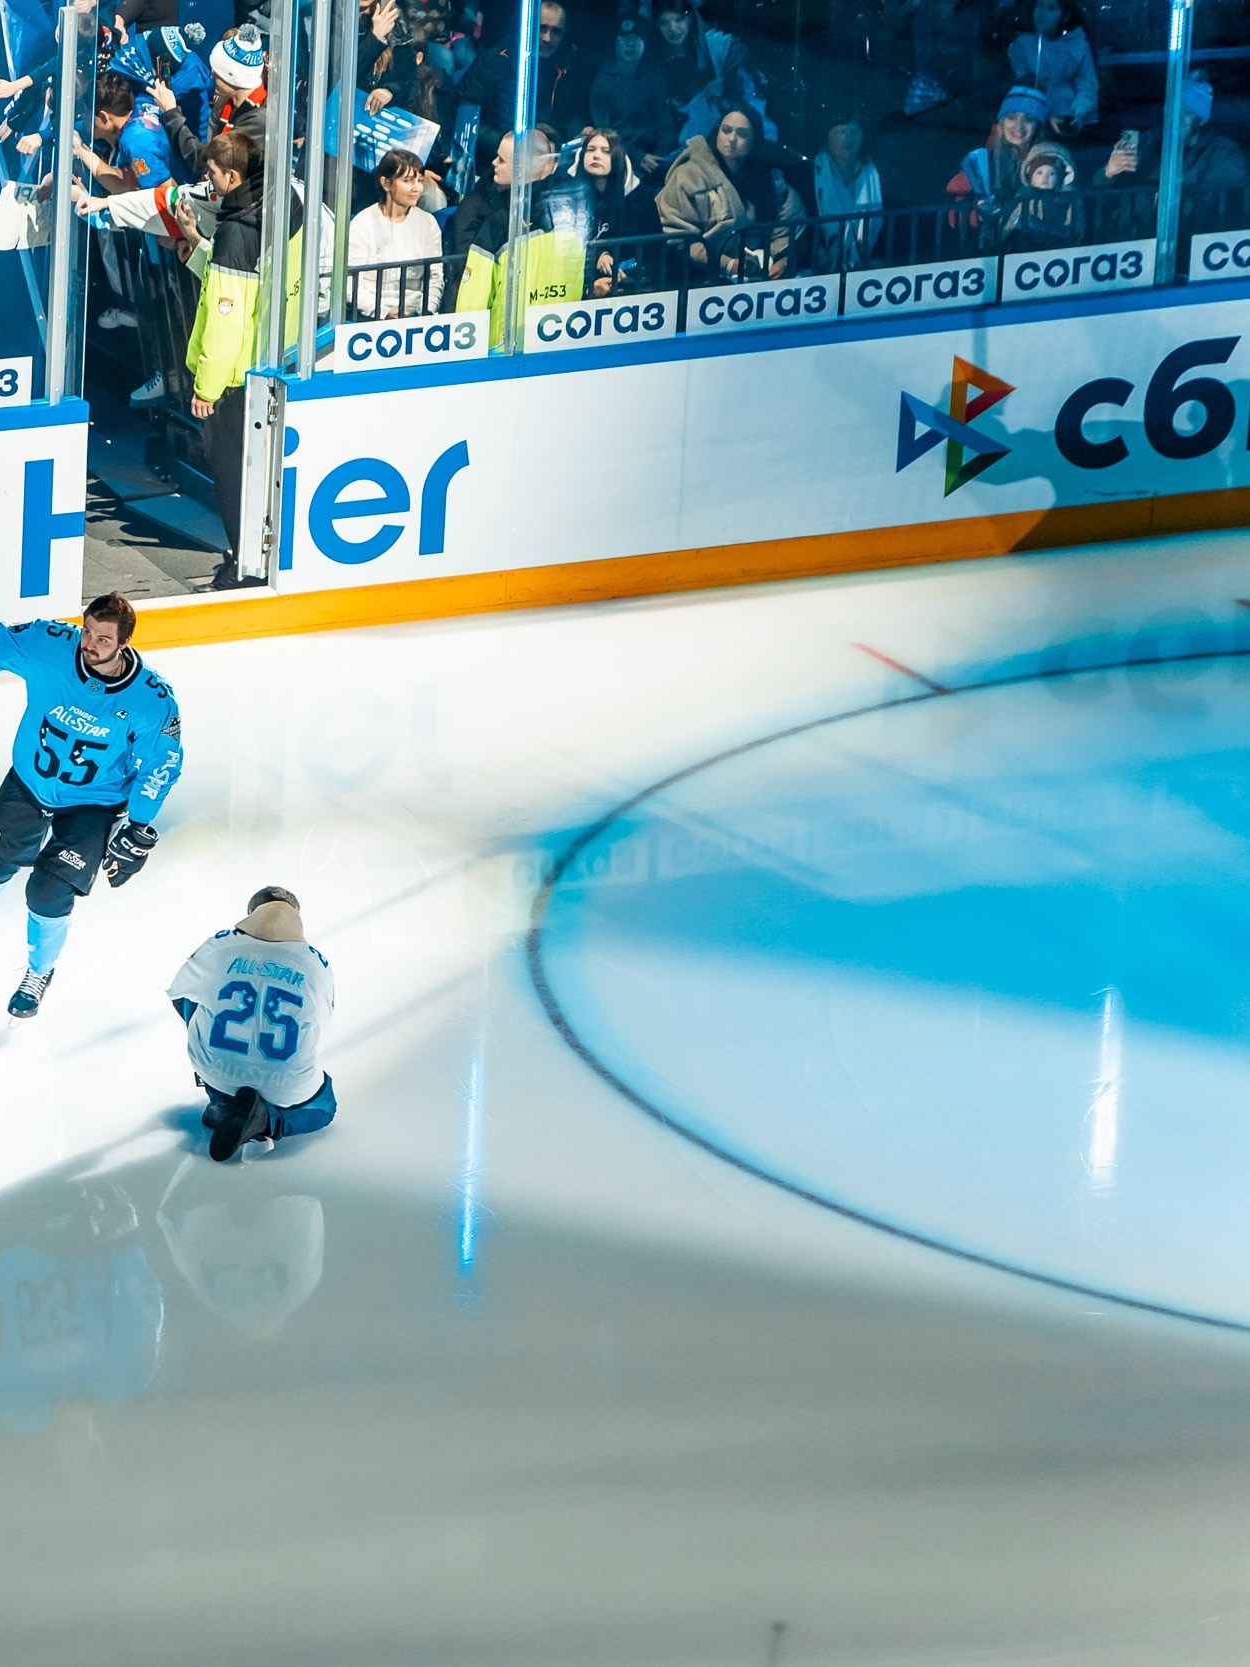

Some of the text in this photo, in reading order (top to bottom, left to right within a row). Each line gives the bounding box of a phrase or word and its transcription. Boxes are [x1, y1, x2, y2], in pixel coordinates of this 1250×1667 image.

[1054, 335, 1250, 470] сб
[34, 713, 109, 786] 55
[69, 705, 99, 723] FONBET
[208, 980, 304, 1062] 25
